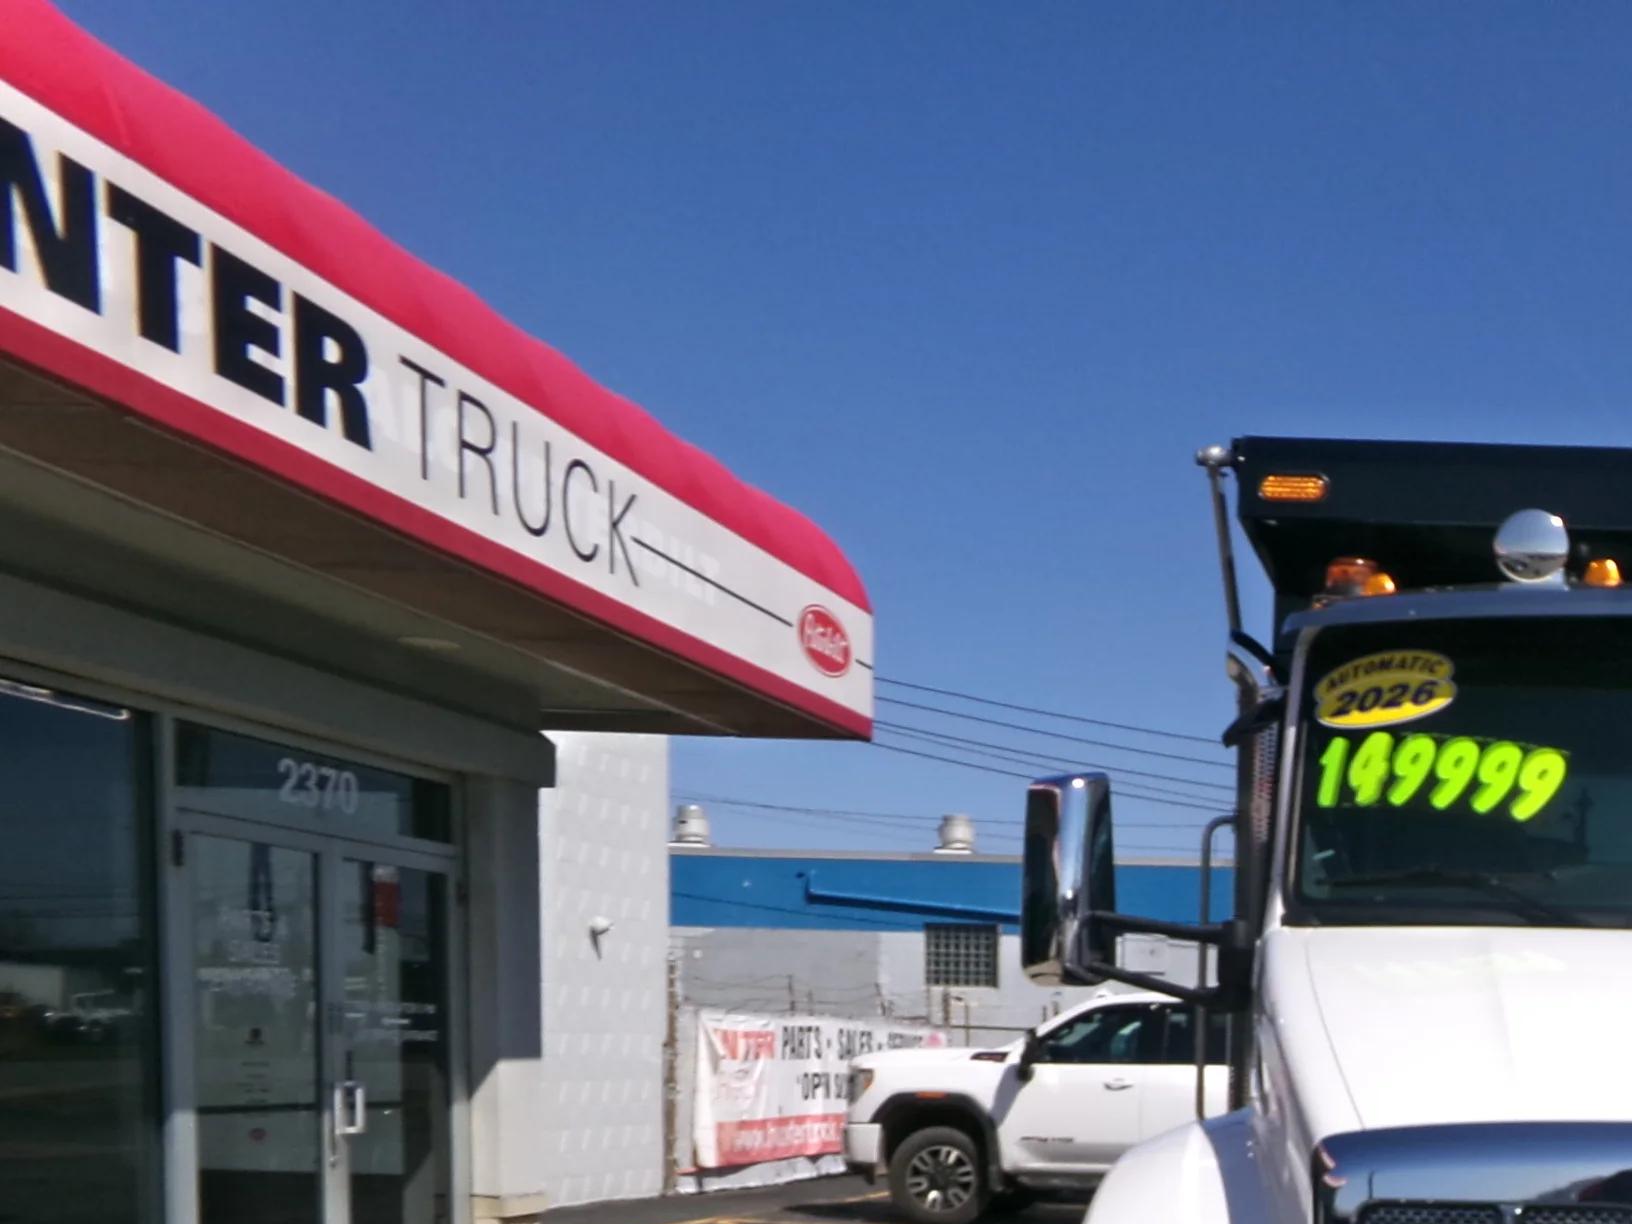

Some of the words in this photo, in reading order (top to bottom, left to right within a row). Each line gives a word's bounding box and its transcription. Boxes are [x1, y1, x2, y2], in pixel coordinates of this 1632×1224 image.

[399, 354, 640, 588] TRUCK
[1326, 654, 1445, 693] AUTOMATIC
[1329, 680, 1440, 718] 2026
[277, 757, 360, 815] 2370
[1317, 731, 1567, 822] 149999
[781, 1025, 822, 1060] PARTS
